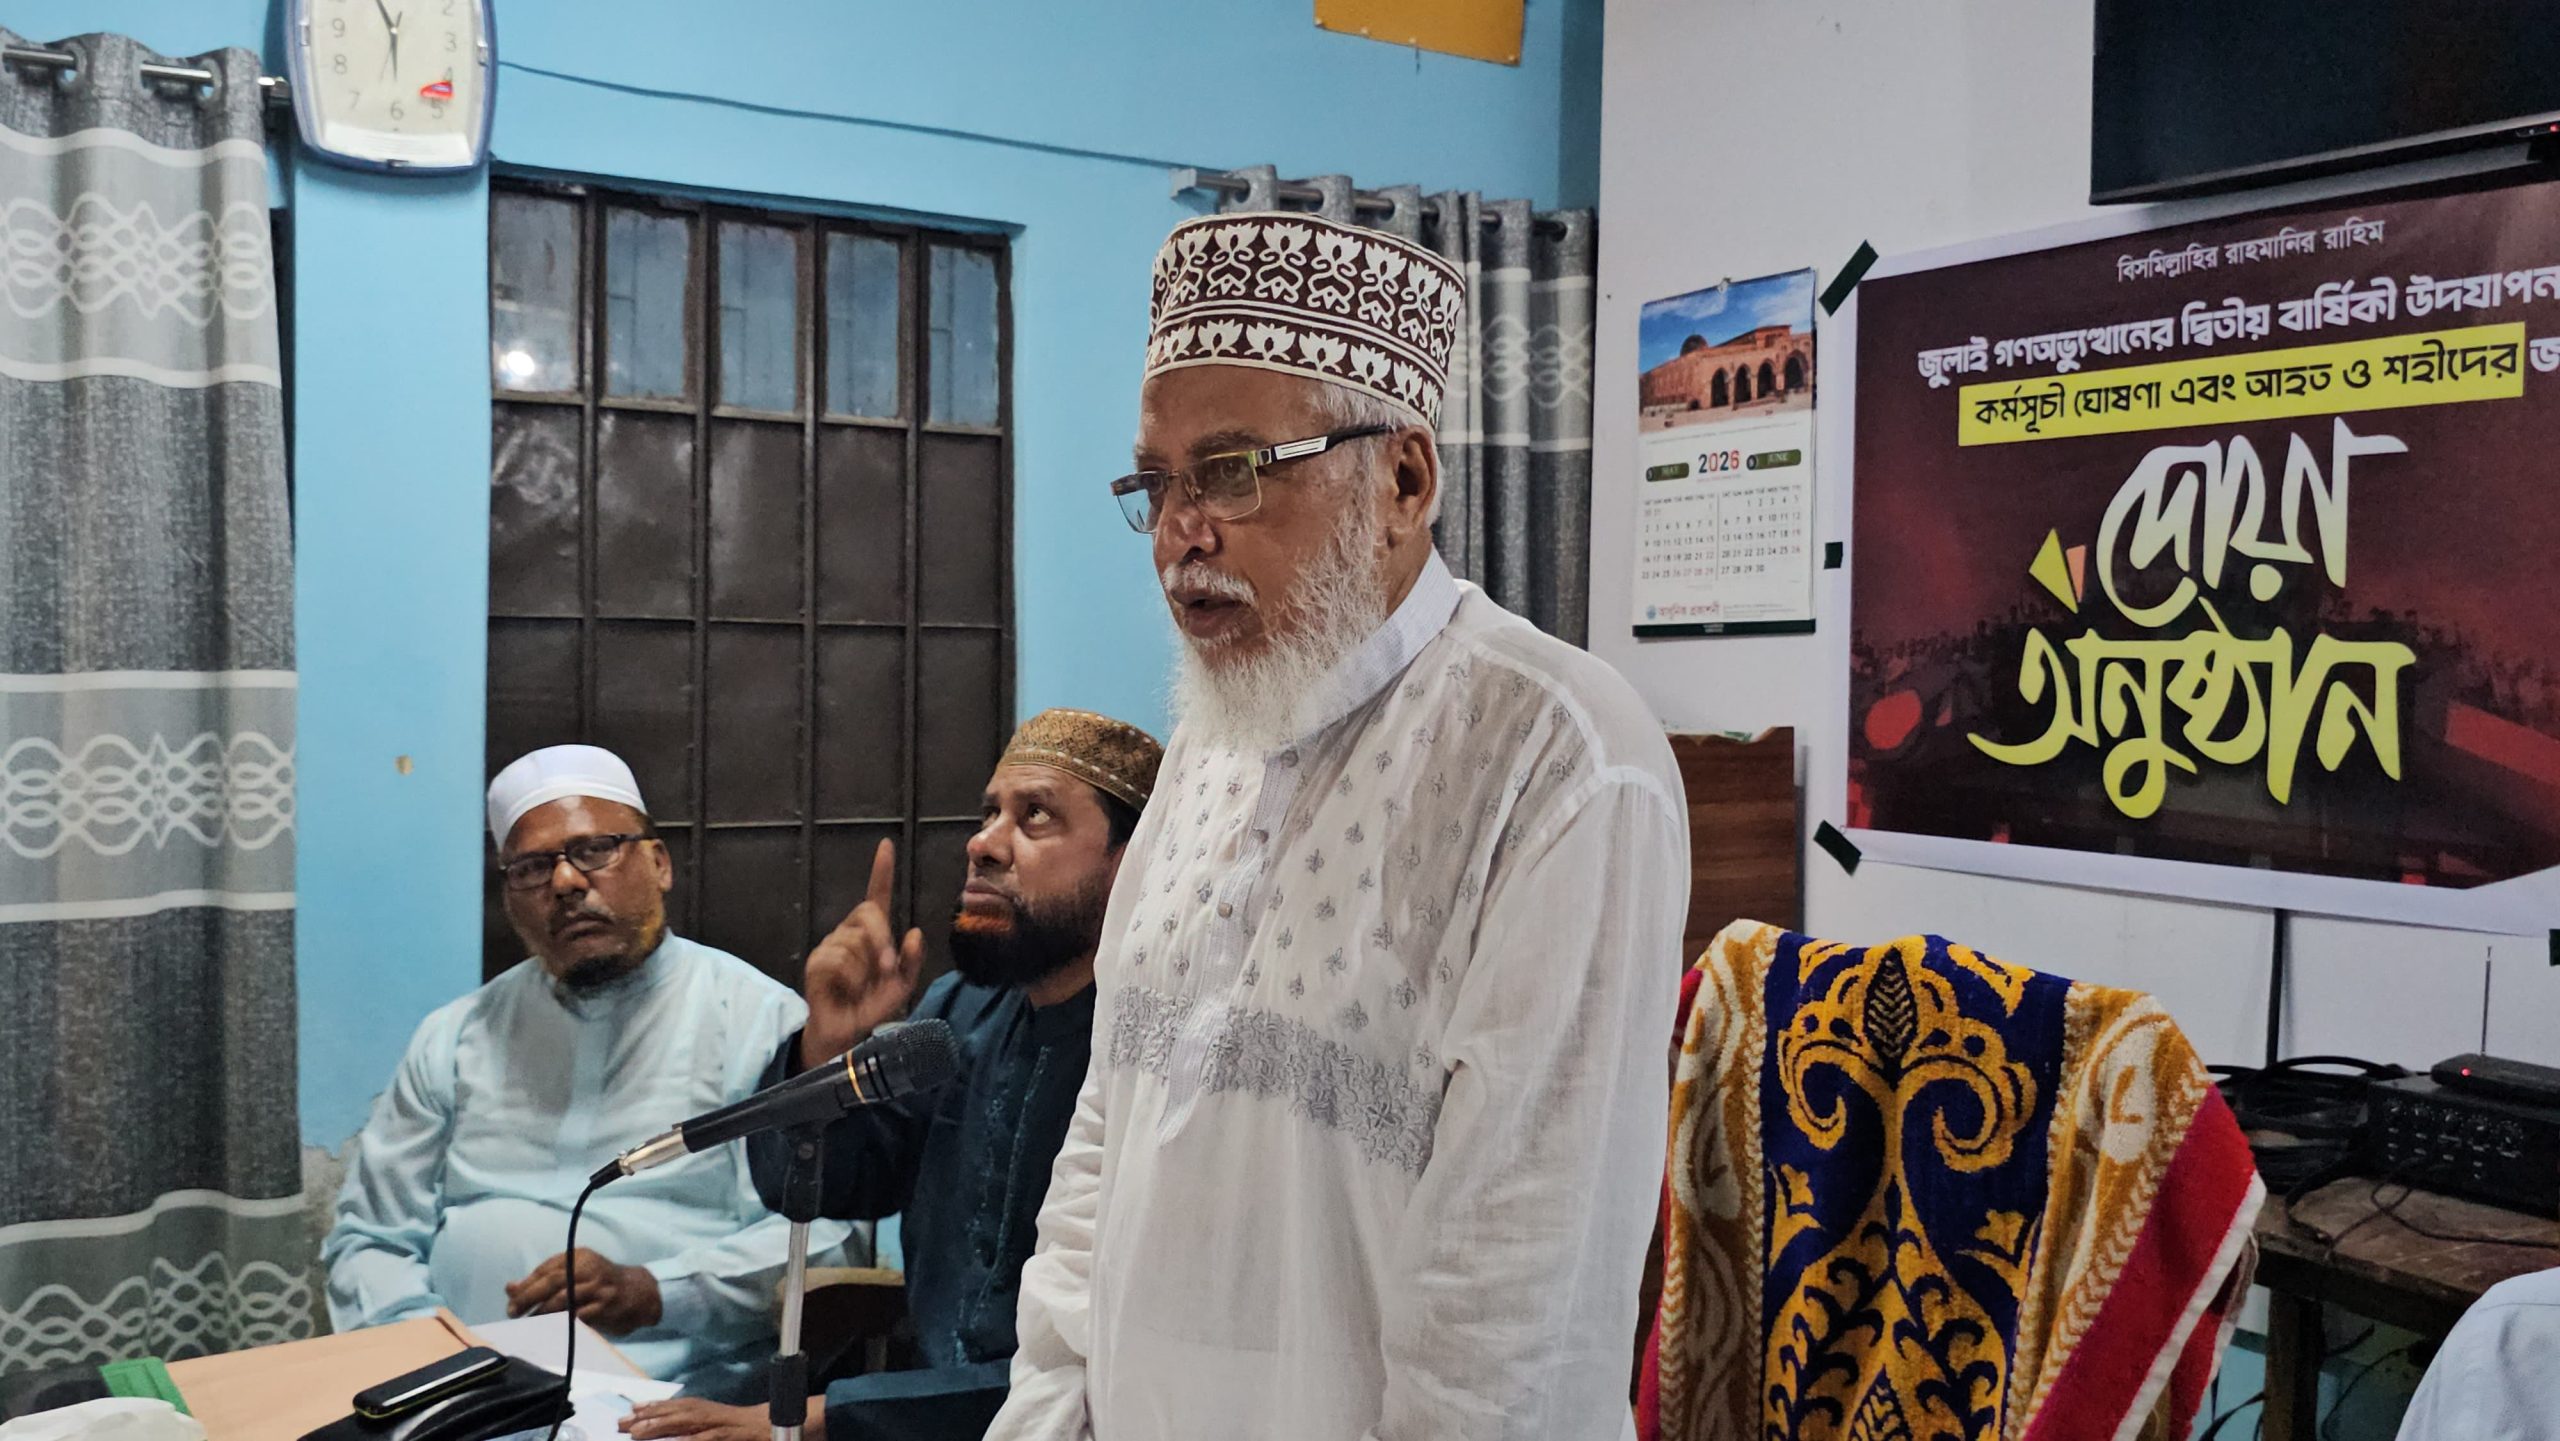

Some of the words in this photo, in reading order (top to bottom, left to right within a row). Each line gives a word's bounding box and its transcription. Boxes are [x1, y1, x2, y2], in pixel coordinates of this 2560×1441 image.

[332, 18, 345, 38] 9
[446, 32, 457, 52] 3
[333, 54, 347, 74] 8
[350, 90, 360, 109] 7
[390, 101, 404, 120] 6
[2117, 242, 2218, 282] বিসমিল্লাহির
[2224, 226, 2316, 265] রাহমানির
[2322, 216, 2385, 250] রাহিম
[1917, 335, 1989, 388] জুলাই
[2181, 298, 2270, 349] দ্বিতীয়
[2278, 280, 2396, 334] বার্ষিকী
[2406, 264, 2560, 318] উদযাপন
[1974, 382, 2066, 434] কর্মসূচী
[2073, 382, 2161, 418] ঘোষণা
[2170, 373, 2237, 406] এবং
[2245, 362, 2332, 398] আহত
[2342, 358, 2372, 390] ও
[2383, 338, 2518, 387] শহীদের
[1698, 449, 1740, 474] 2026
[1966, 597, 2416, 818] অনুষ্ঠান
